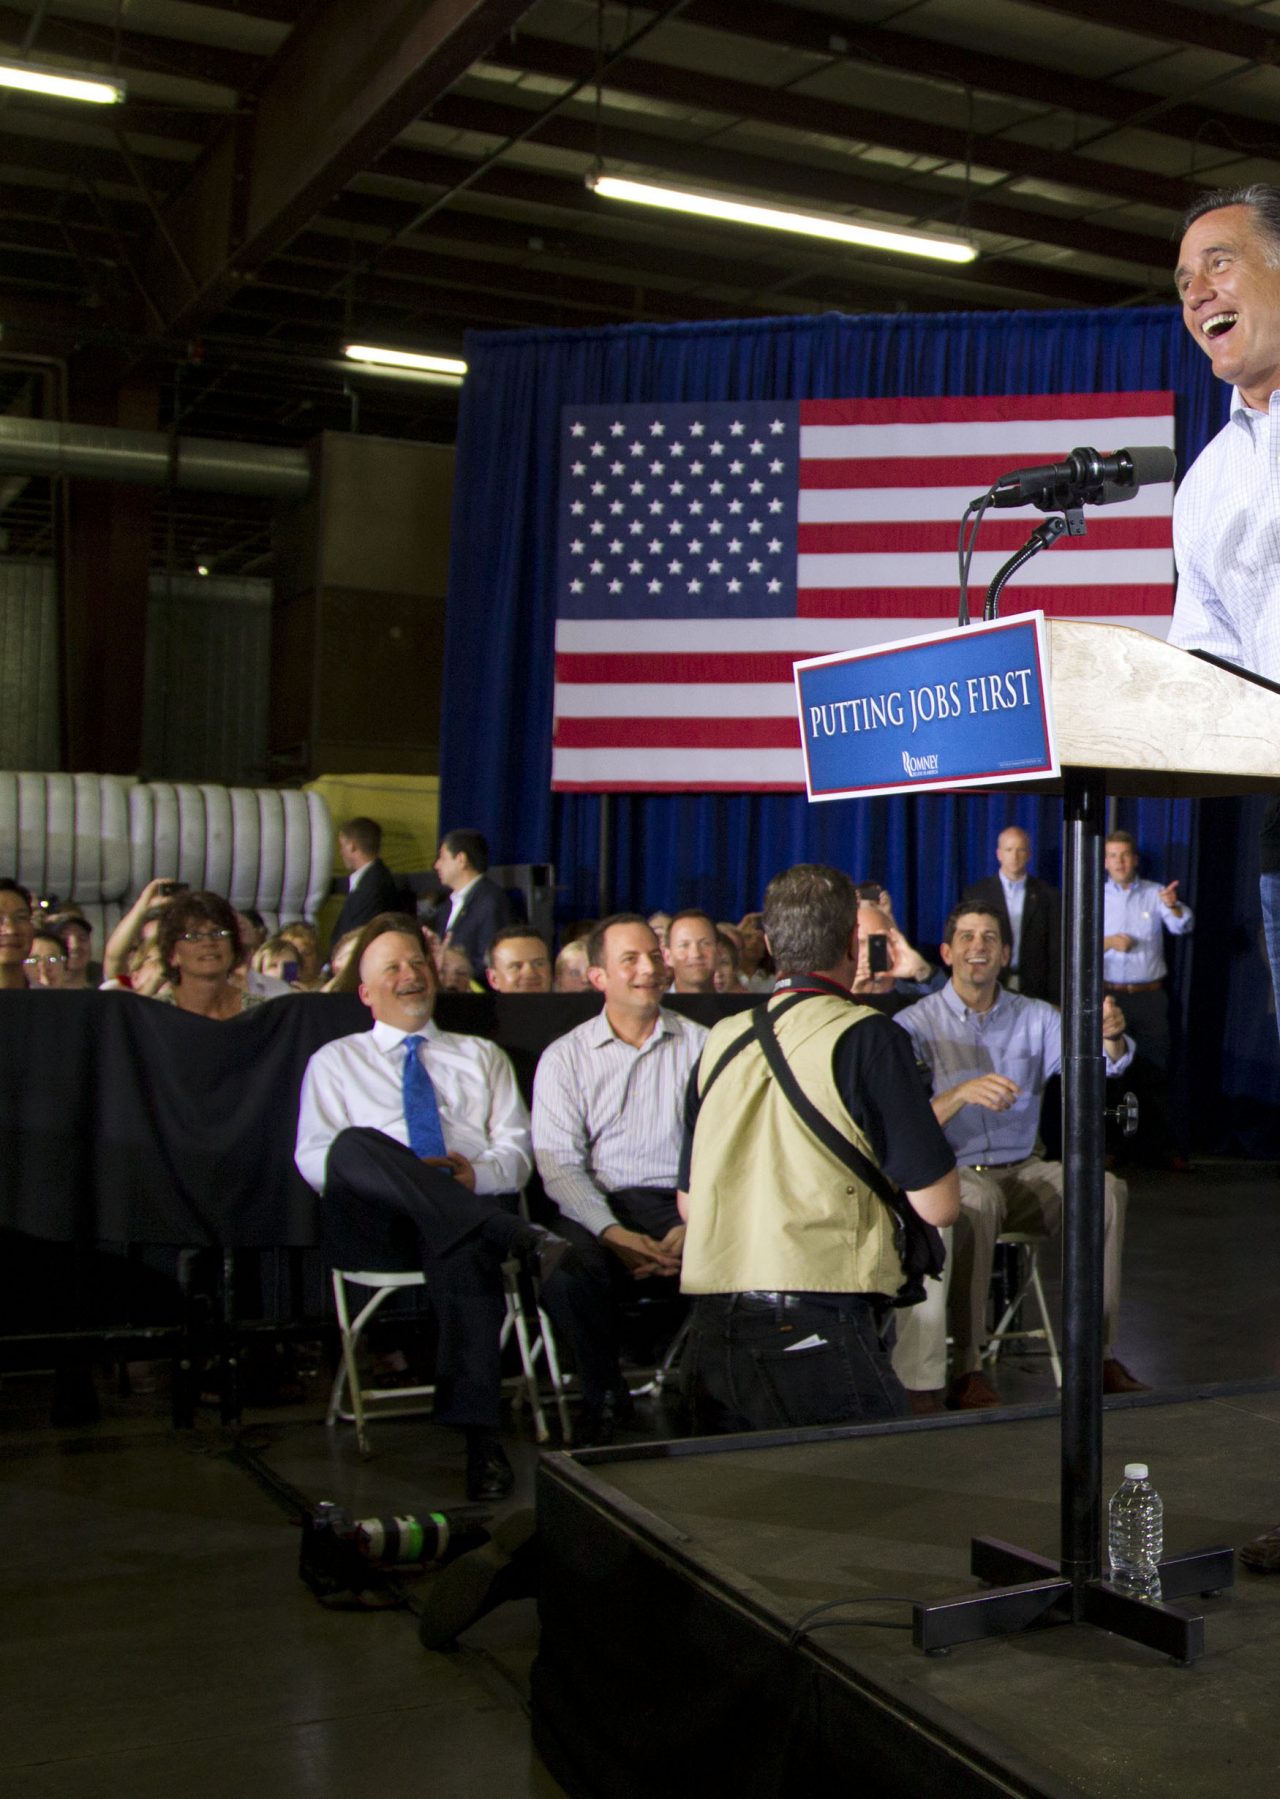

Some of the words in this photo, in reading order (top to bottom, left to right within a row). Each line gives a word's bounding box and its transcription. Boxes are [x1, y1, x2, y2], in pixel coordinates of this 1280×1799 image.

[809, 692, 904, 738] PUTTING
[908, 681, 962, 733] JOBS
[966, 668, 1032, 714] FIRST
